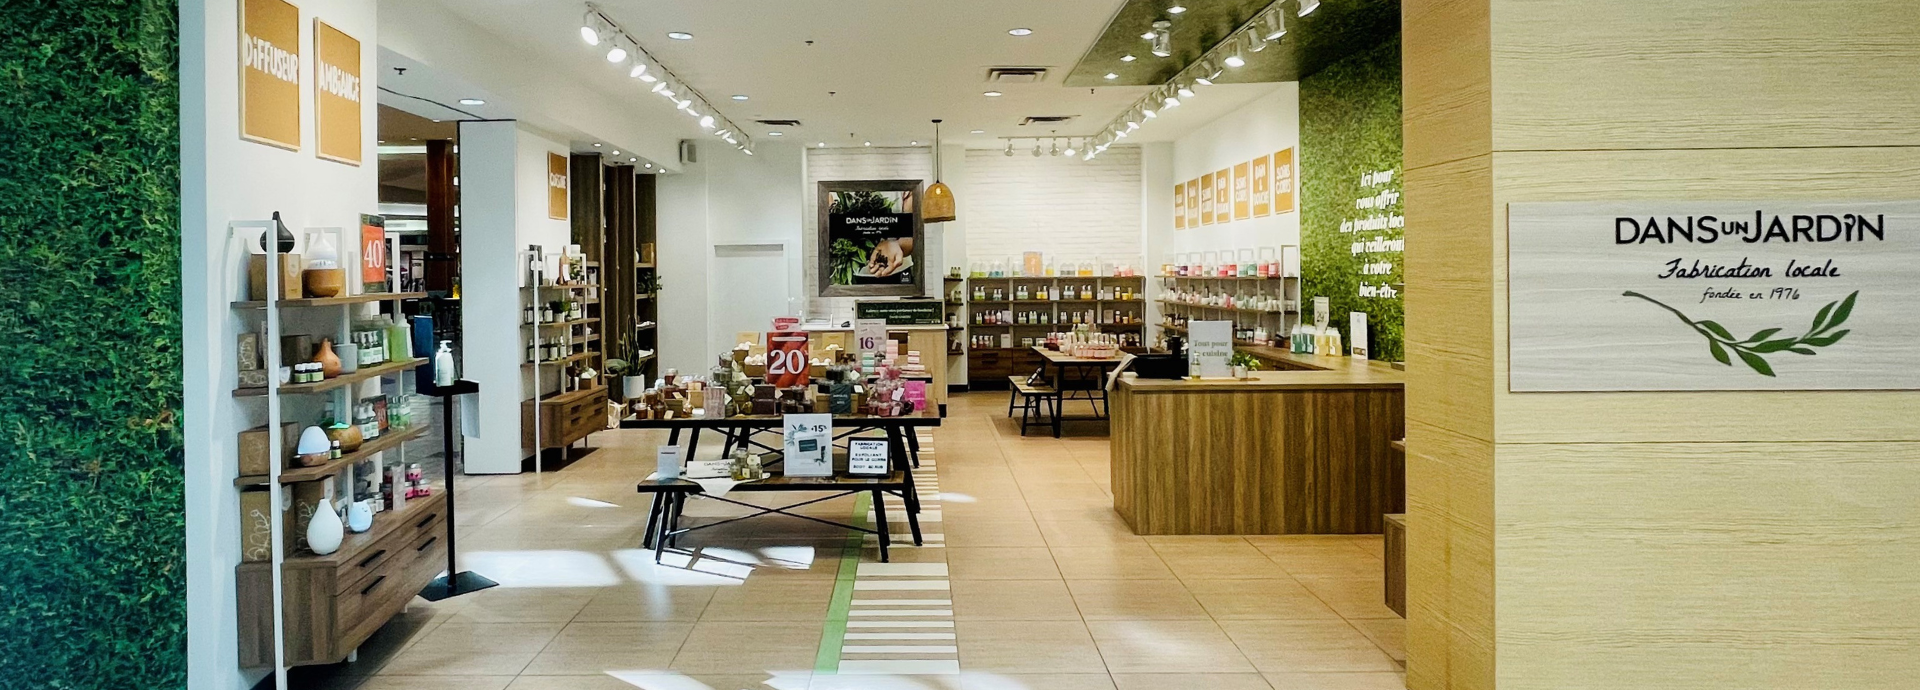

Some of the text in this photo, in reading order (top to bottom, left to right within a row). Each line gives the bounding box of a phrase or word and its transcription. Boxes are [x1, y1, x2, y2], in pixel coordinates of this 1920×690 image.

[1372, 169, 1394, 188] pour
[1375, 188, 1400, 210] offrir
[1339, 218, 1353, 233] des
[1352, 212, 1388, 235] produits
[1615, 215, 1719, 244] DANS
[1721, 220, 1749, 236] UN
[1370, 260, 1393, 275] votre
[1657, 257, 1842, 280] Fabrication locale
[1358, 281, 1398, 299] bien-être
[1699, 287, 1801, 304] fondée en 1976
[859, 336, 874, 349] 16
[769, 349, 805, 375] 20
